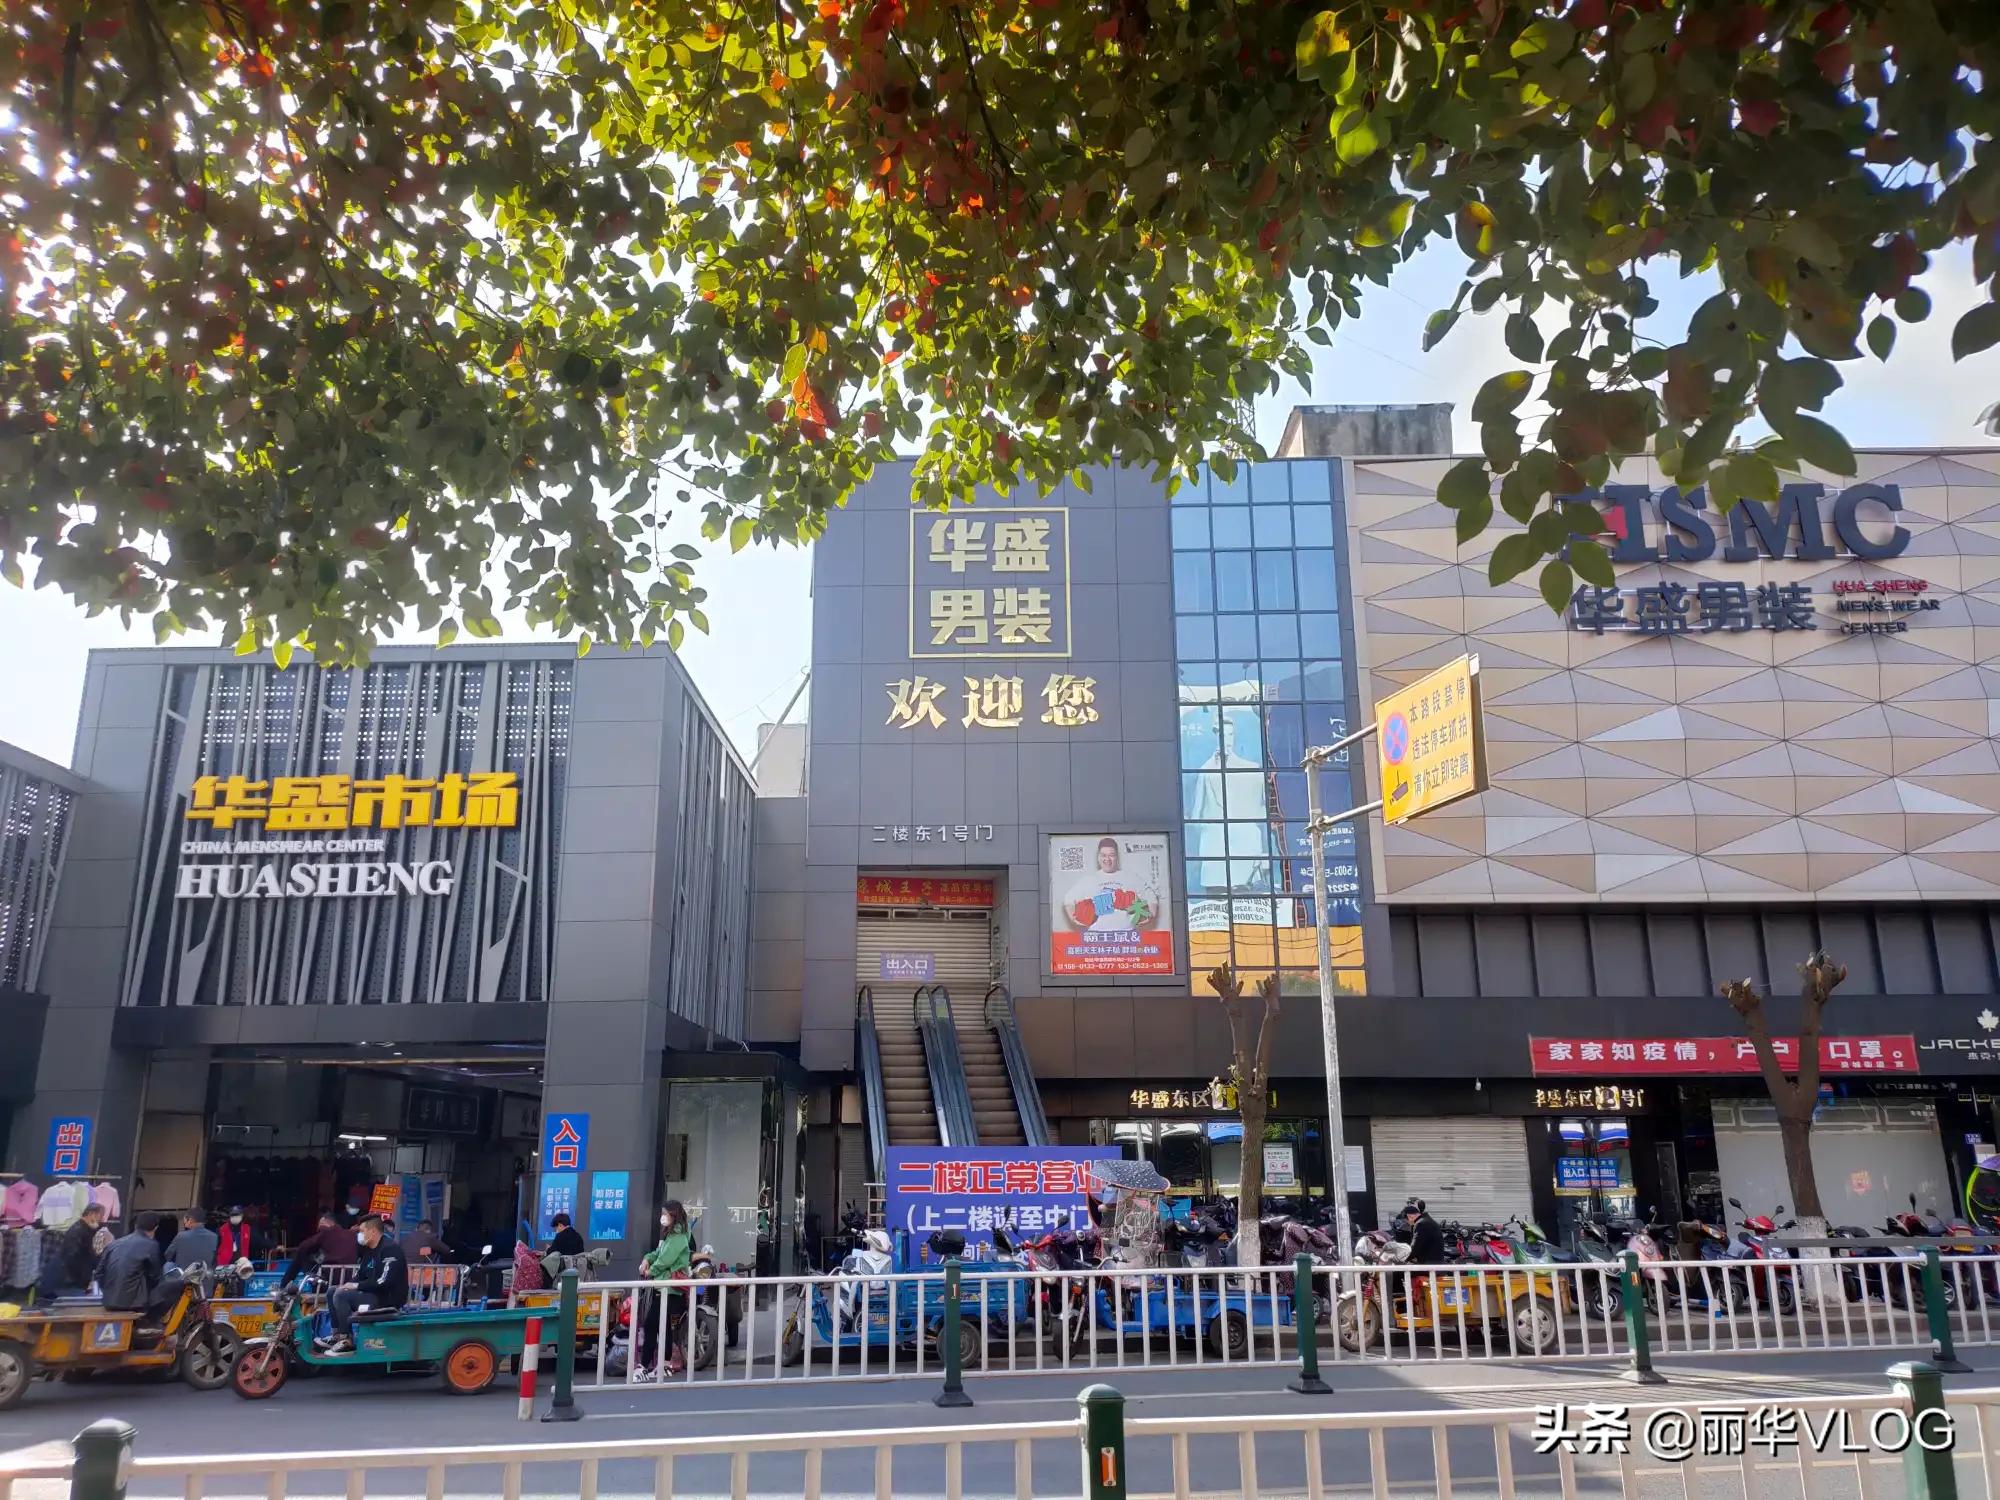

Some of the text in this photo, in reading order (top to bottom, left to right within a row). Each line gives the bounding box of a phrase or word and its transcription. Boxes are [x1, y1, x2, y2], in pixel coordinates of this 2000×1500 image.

[928, 518, 1050, 572] 华盛
[1570, 581, 1818, 636] 华盛男装
[1871, 579, 1929, 592] SHENG
[930, 587, 1052, 645] 男装
[1840, 621, 1909, 635] CENTER
[885, 673, 1099, 729] 欢迎您
[1408, 676, 1467, 724] 本路段禁停
[185, 772, 519, 831] 华盛市场
[180, 841, 232, 854] CHINA
[325, 839, 385, 852] CENTER
[872, 825, 993, 842] 二楼东1号门
[175, 860, 454, 898] HUASHENG
[886, 959, 928, 970] 出入口
[1549, 1039, 1903, 1061] 家家知疫情，户户口罩。
[54, 1122, 84, 1172] 出口
[552, 1118, 581, 1168] 入口
